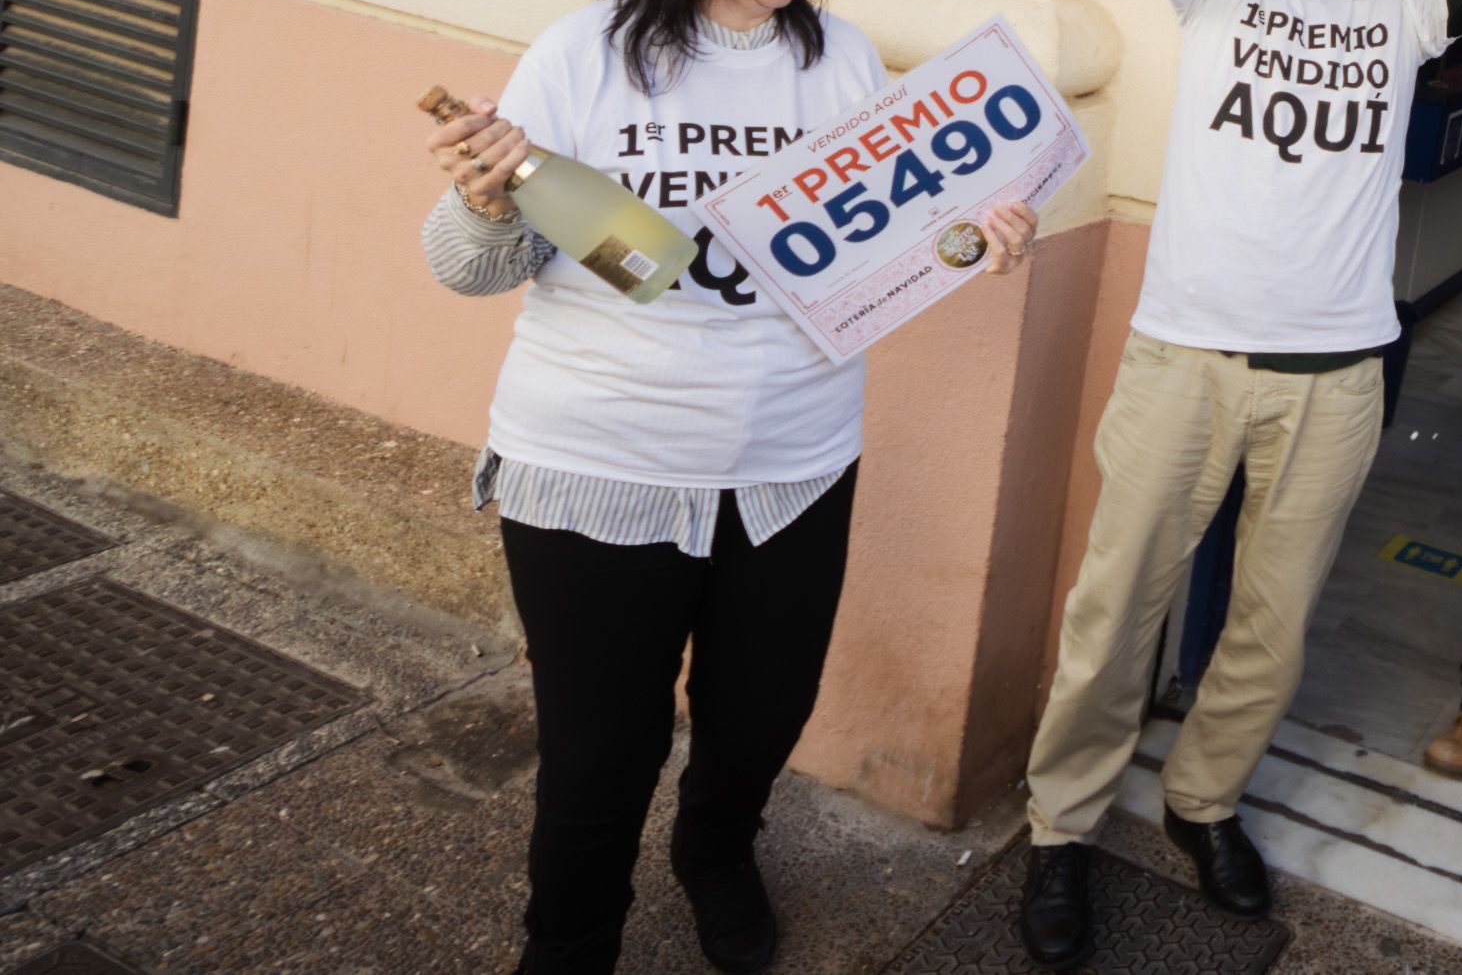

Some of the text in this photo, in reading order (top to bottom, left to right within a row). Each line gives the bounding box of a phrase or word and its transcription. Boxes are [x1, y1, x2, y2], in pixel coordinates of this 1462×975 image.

[1233, 36, 1390, 91] VENDIDO
[1266, 10, 1389, 53] PREMIO
[618, 121, 809, 157] 1er PREM
[756, 69, 988, 223] 1er PREMIO
[807, 84, 909, 153] VENDIDO AQUÍ
[1209, 81, 1389, 164] AQUÍ
[769, 84, 1042, 278] 05490
[835, 304, 876, 333] LOTERÍA
[887, 266, 932, 298] NAVIDAD
